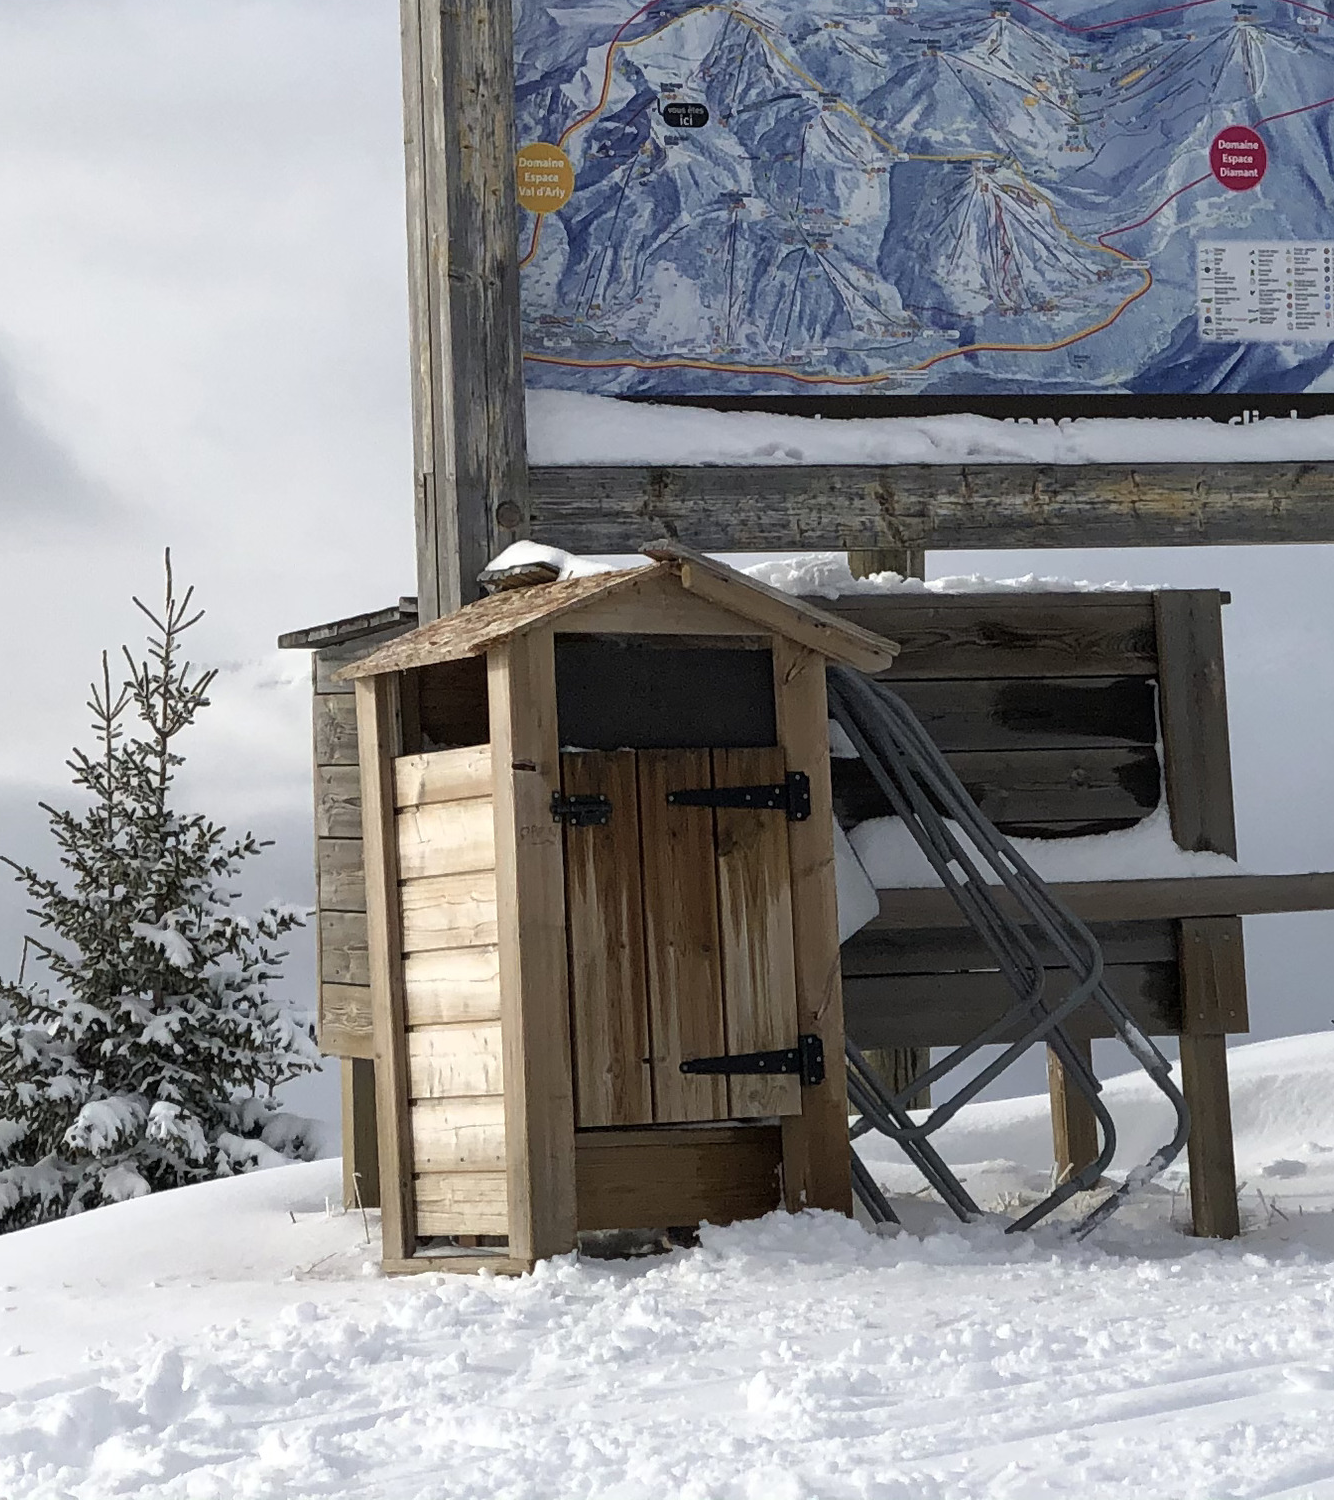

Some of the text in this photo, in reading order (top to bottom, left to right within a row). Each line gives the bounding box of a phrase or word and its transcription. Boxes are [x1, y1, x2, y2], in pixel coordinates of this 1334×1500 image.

[679, 114, 693, 126] ici
[1218, 140, 1259, 149] Domaine
[518, 157, 564, 168] Domaine
[1222, 154, 1253, 165] Espace
[1220, 167, 1258, 177] Diamant
[524, 173, 559, 184] Espace
[519, 187, 566, 199] Val d'Arly
